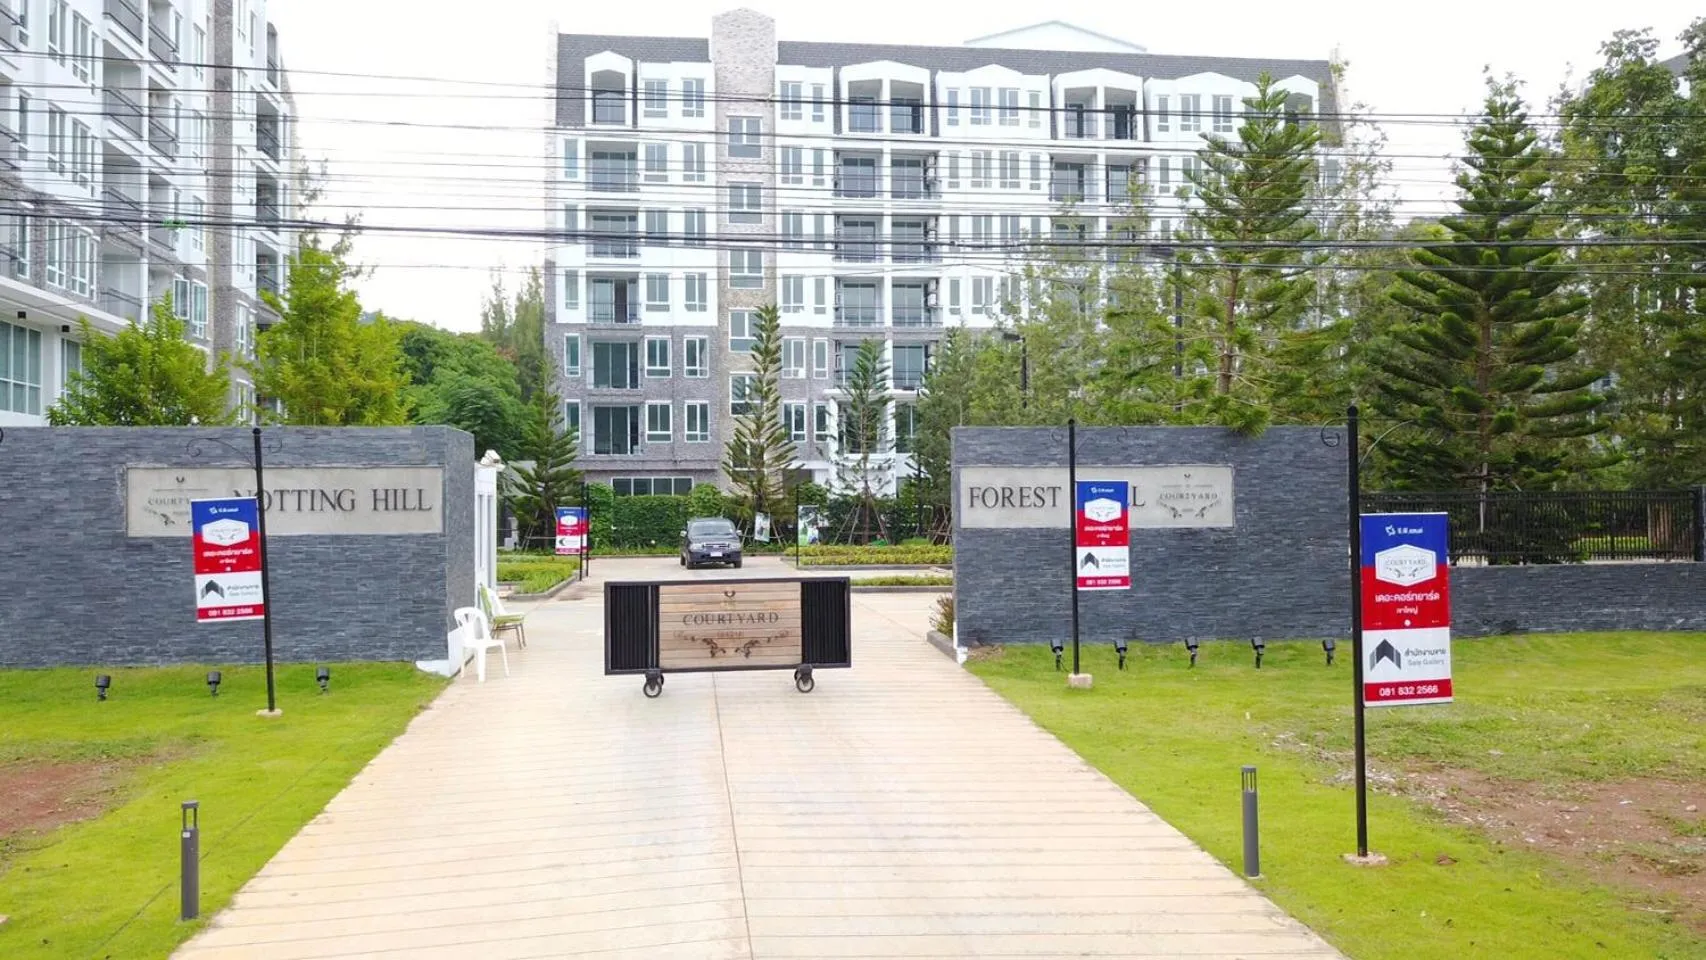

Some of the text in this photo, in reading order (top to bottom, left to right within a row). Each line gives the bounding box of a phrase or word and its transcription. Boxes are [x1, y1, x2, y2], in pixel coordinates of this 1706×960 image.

[371, 488, 433, 511] HILL
[968, 486, 1062, 509] FOREST
[682, 612, 780, 626] COURTYARD
